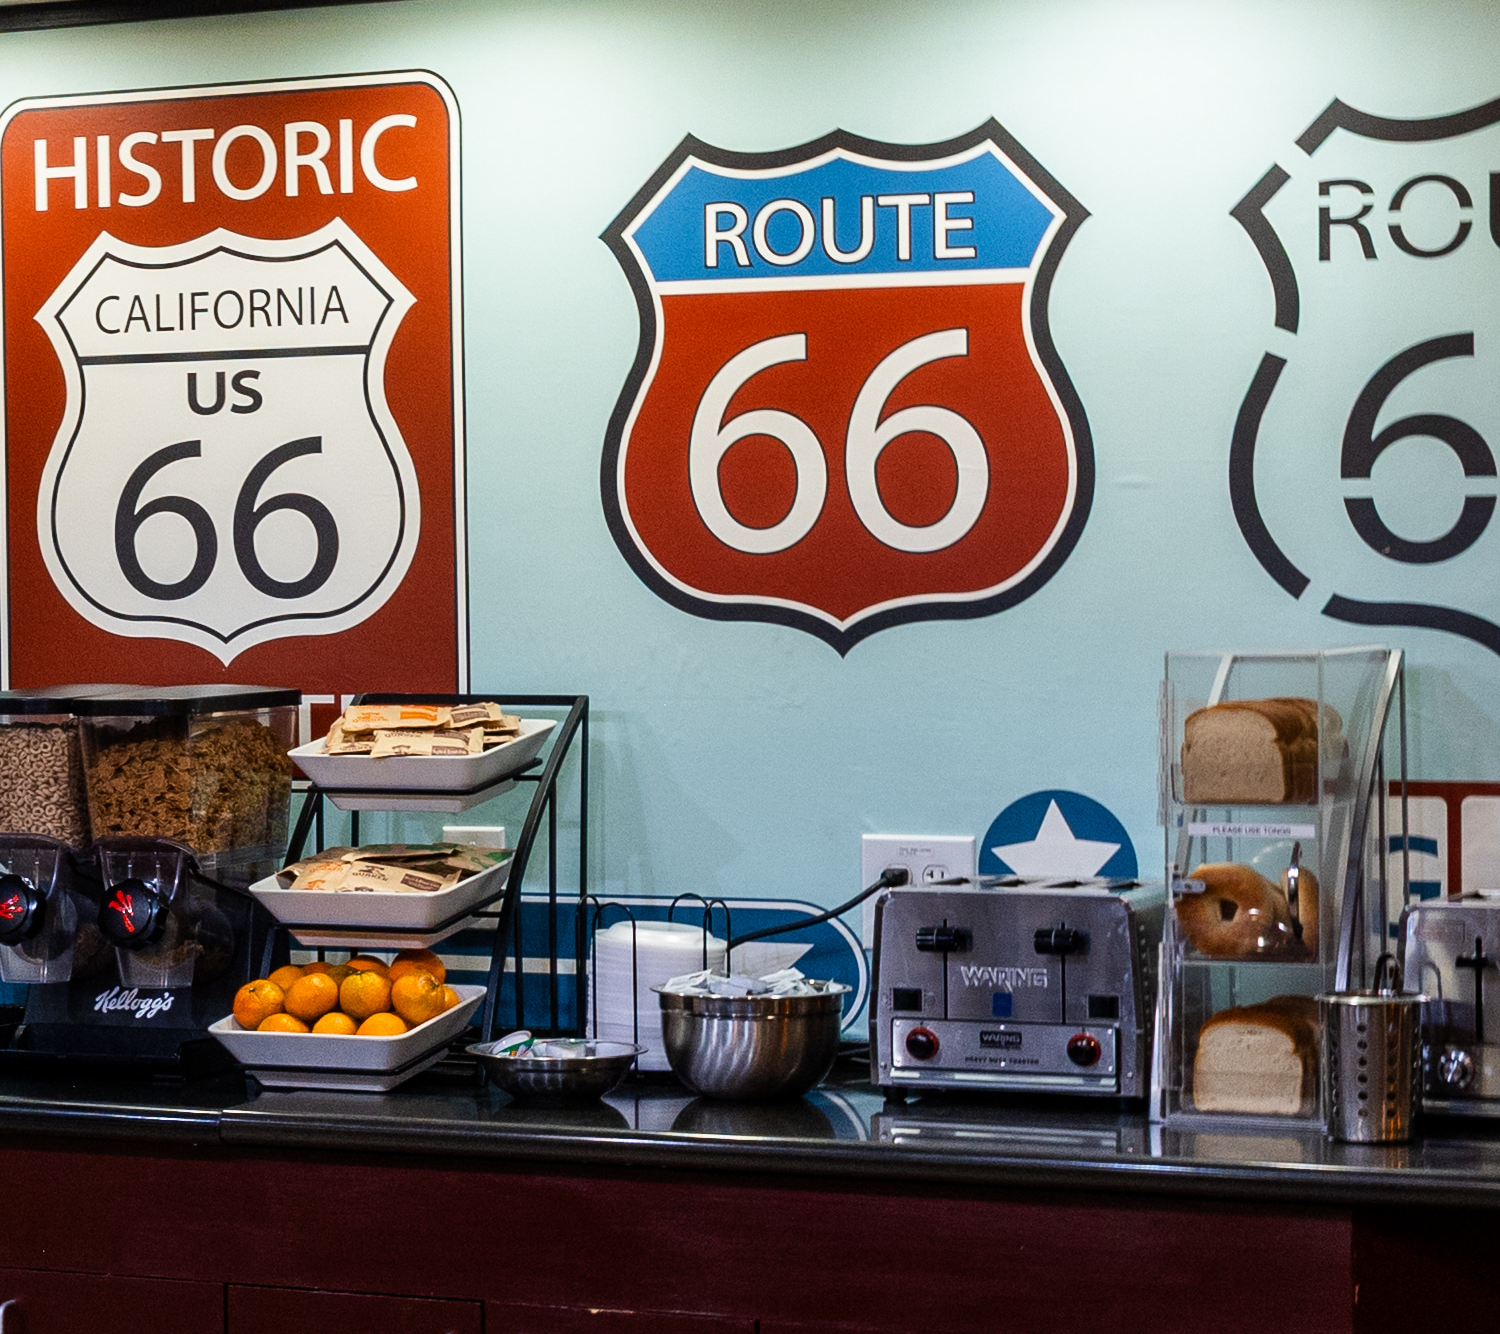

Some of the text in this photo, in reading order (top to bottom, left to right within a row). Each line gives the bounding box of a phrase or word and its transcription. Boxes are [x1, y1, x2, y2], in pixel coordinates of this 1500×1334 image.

[33, 113, 419, 213] HISTORIC
[703, 188, 980, 269] ROUTE
[93, 283, 350, 335] CALIFORNIA
[187, 369, 263, 416] US
[688, 328, 990, 555] 66
[114, 436, 340, 601] 66
[94, 985, 175, 1019] Kellogg's
[960, 965, 1048, 992] WARING
